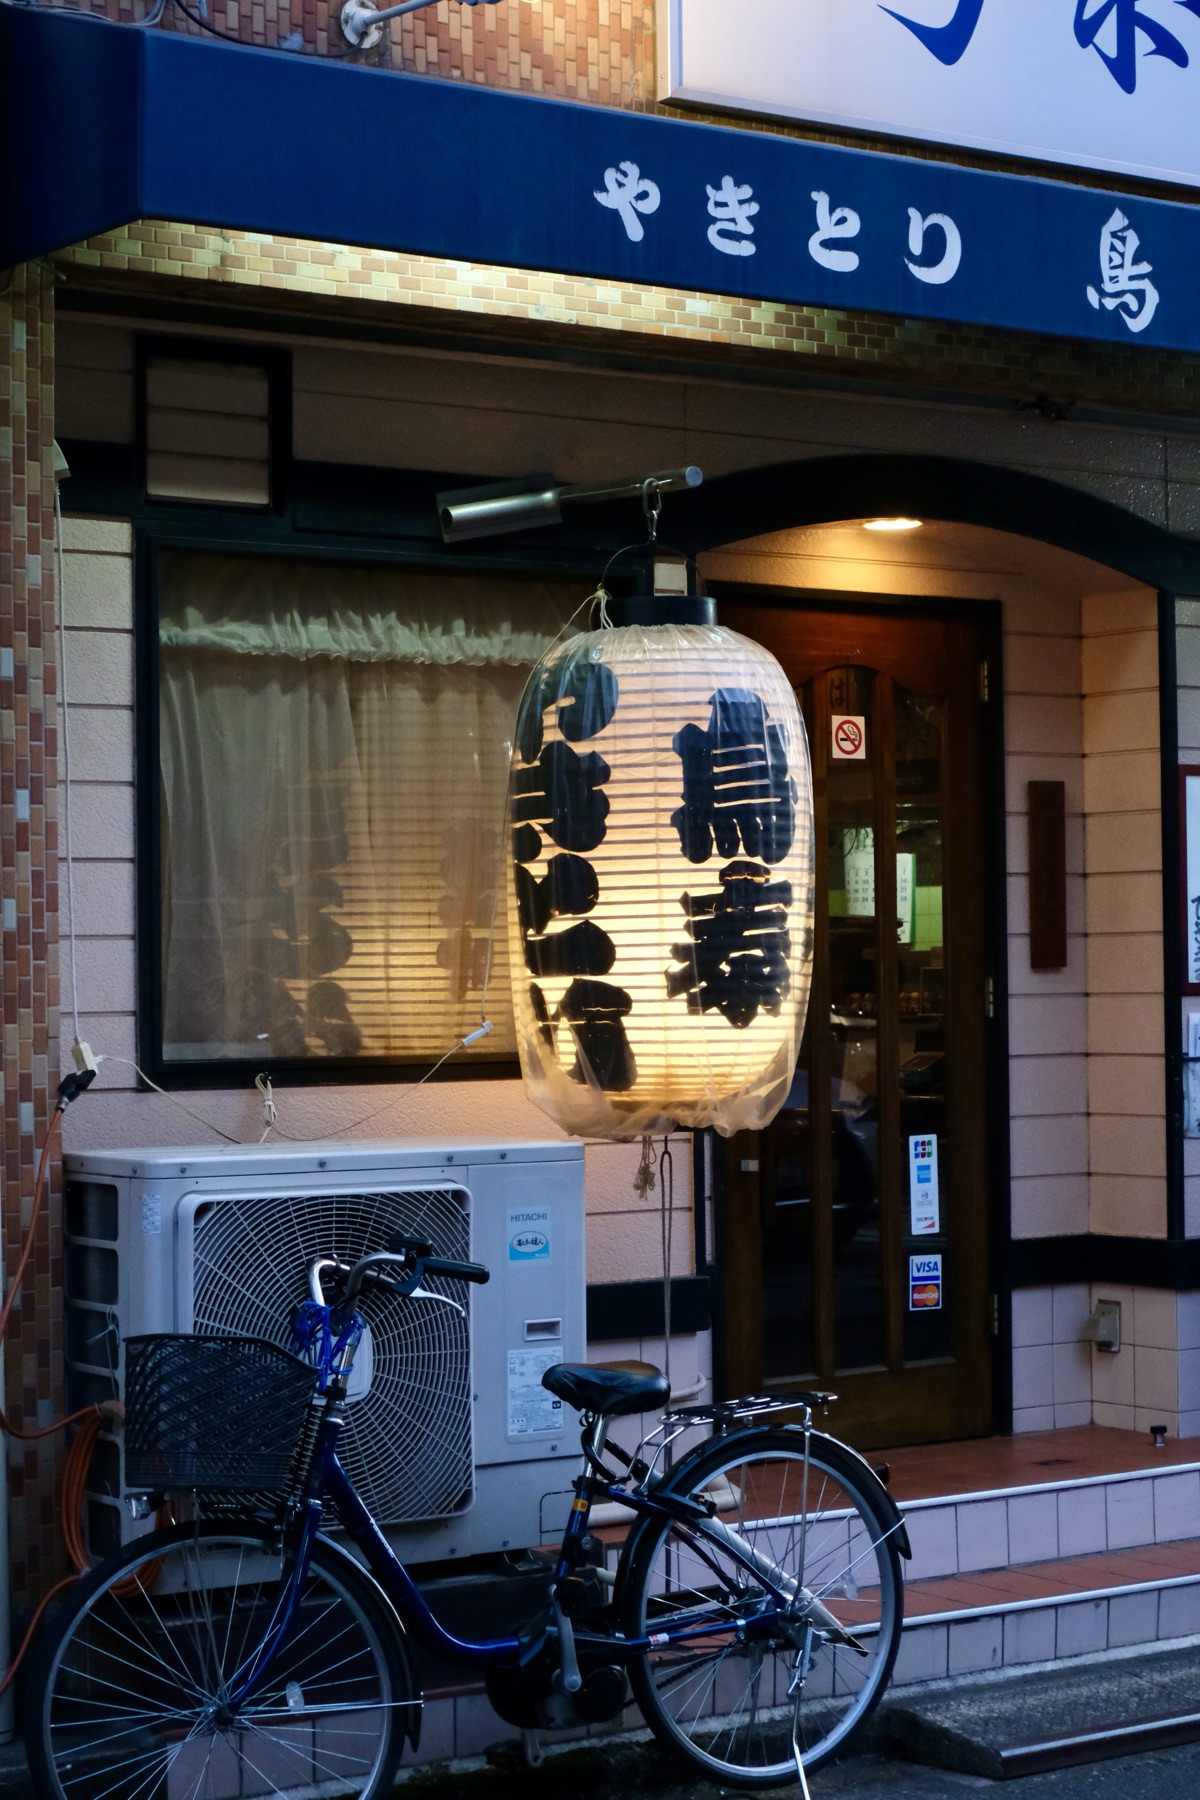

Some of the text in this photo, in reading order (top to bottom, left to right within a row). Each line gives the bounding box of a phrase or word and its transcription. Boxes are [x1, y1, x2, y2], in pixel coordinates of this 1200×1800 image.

[593, 160, 1160, 333] やきとり 鳥
[510, 1213, 547, 1222] HITACHI
[914, 1261, 939, 1273] VISA
